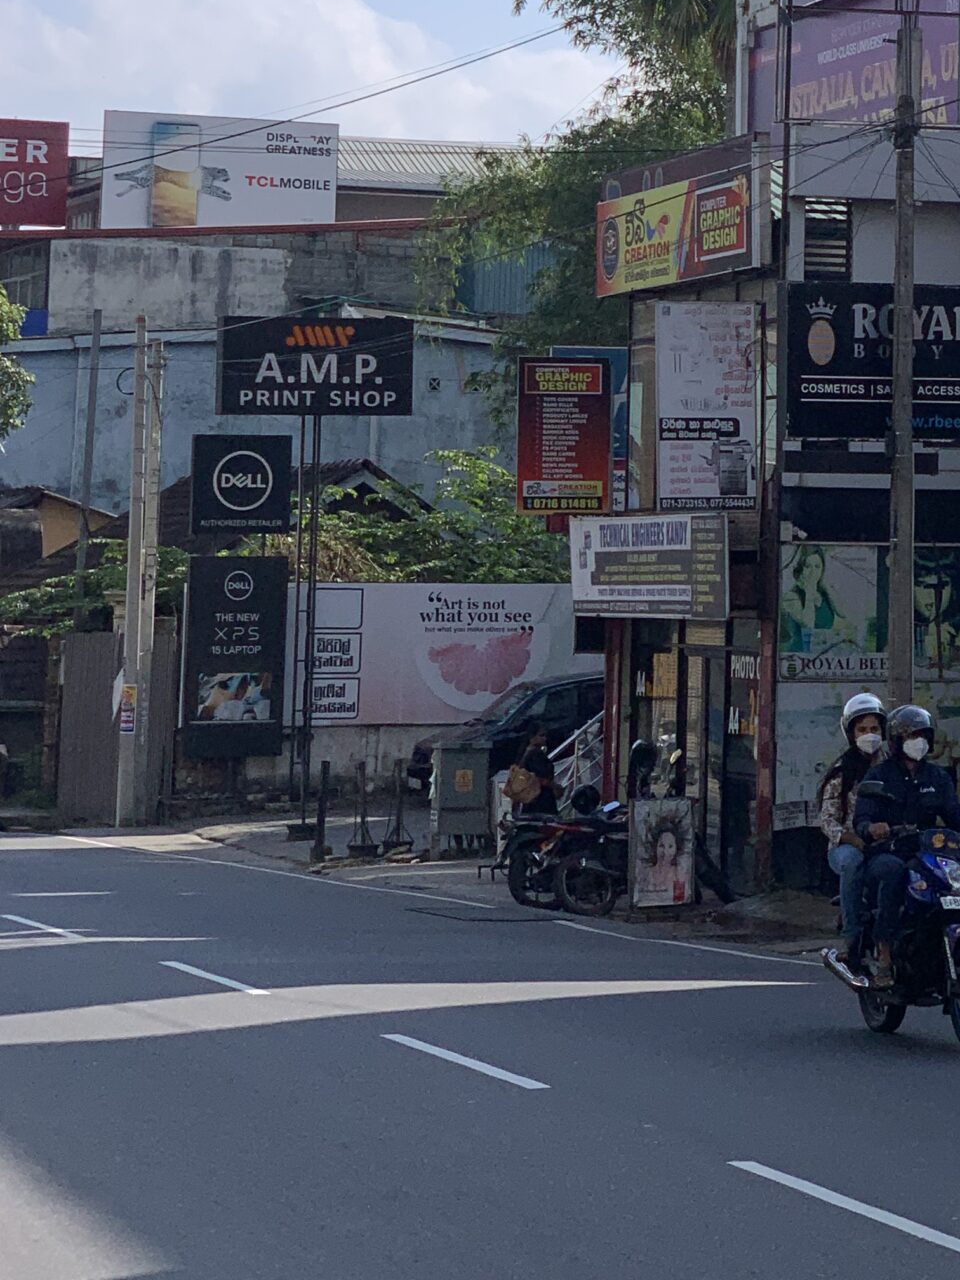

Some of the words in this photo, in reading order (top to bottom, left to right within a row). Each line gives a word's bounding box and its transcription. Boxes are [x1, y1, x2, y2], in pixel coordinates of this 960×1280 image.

[266, 144, 332, 157] GREATNESS
[0, 170, 49, 204] ga
[700, 196, 727, 212] COMPUTER
[700, 205, 741, 231] GRAPHIC
[703, 225, 737, 250] DESIGN
[624, 239, 671, 265] CREATION
[255, 352, 383, 384] A.M.P.
[535, 372, 593, 382] GRAPHIC
[539, 381, 587, 391] DESIGN
[800, 383, 865, 395] COSMETICS
[239, 389, 316, 407] PRINT
[329, 391, 397, 408] SHOP
[221, 472, 266, 489] DELL
[599, 523, 629, 548] TECHNICAL
[631, 521, 665, 547] ENGINEERS
[666, 520, 688, 546] KANDY
[228, 581, 250, 590] DELL
[467, 598, 480, 610] is
[483, 599, 506, 610] not
[215, 613, 234, 621] THE
[236, 613, 260, 622] NEW
[420, 608, 463, 623] what
[467, 611, 499, 626] you
[504, 611, 532, 623] see
[214, 626, 260, 641] XPS
[222, 645, 262, 655] LAPTOP
[730, 654, 755, 680] PHOTO
[801, 656, 853, 671] ROYAL
